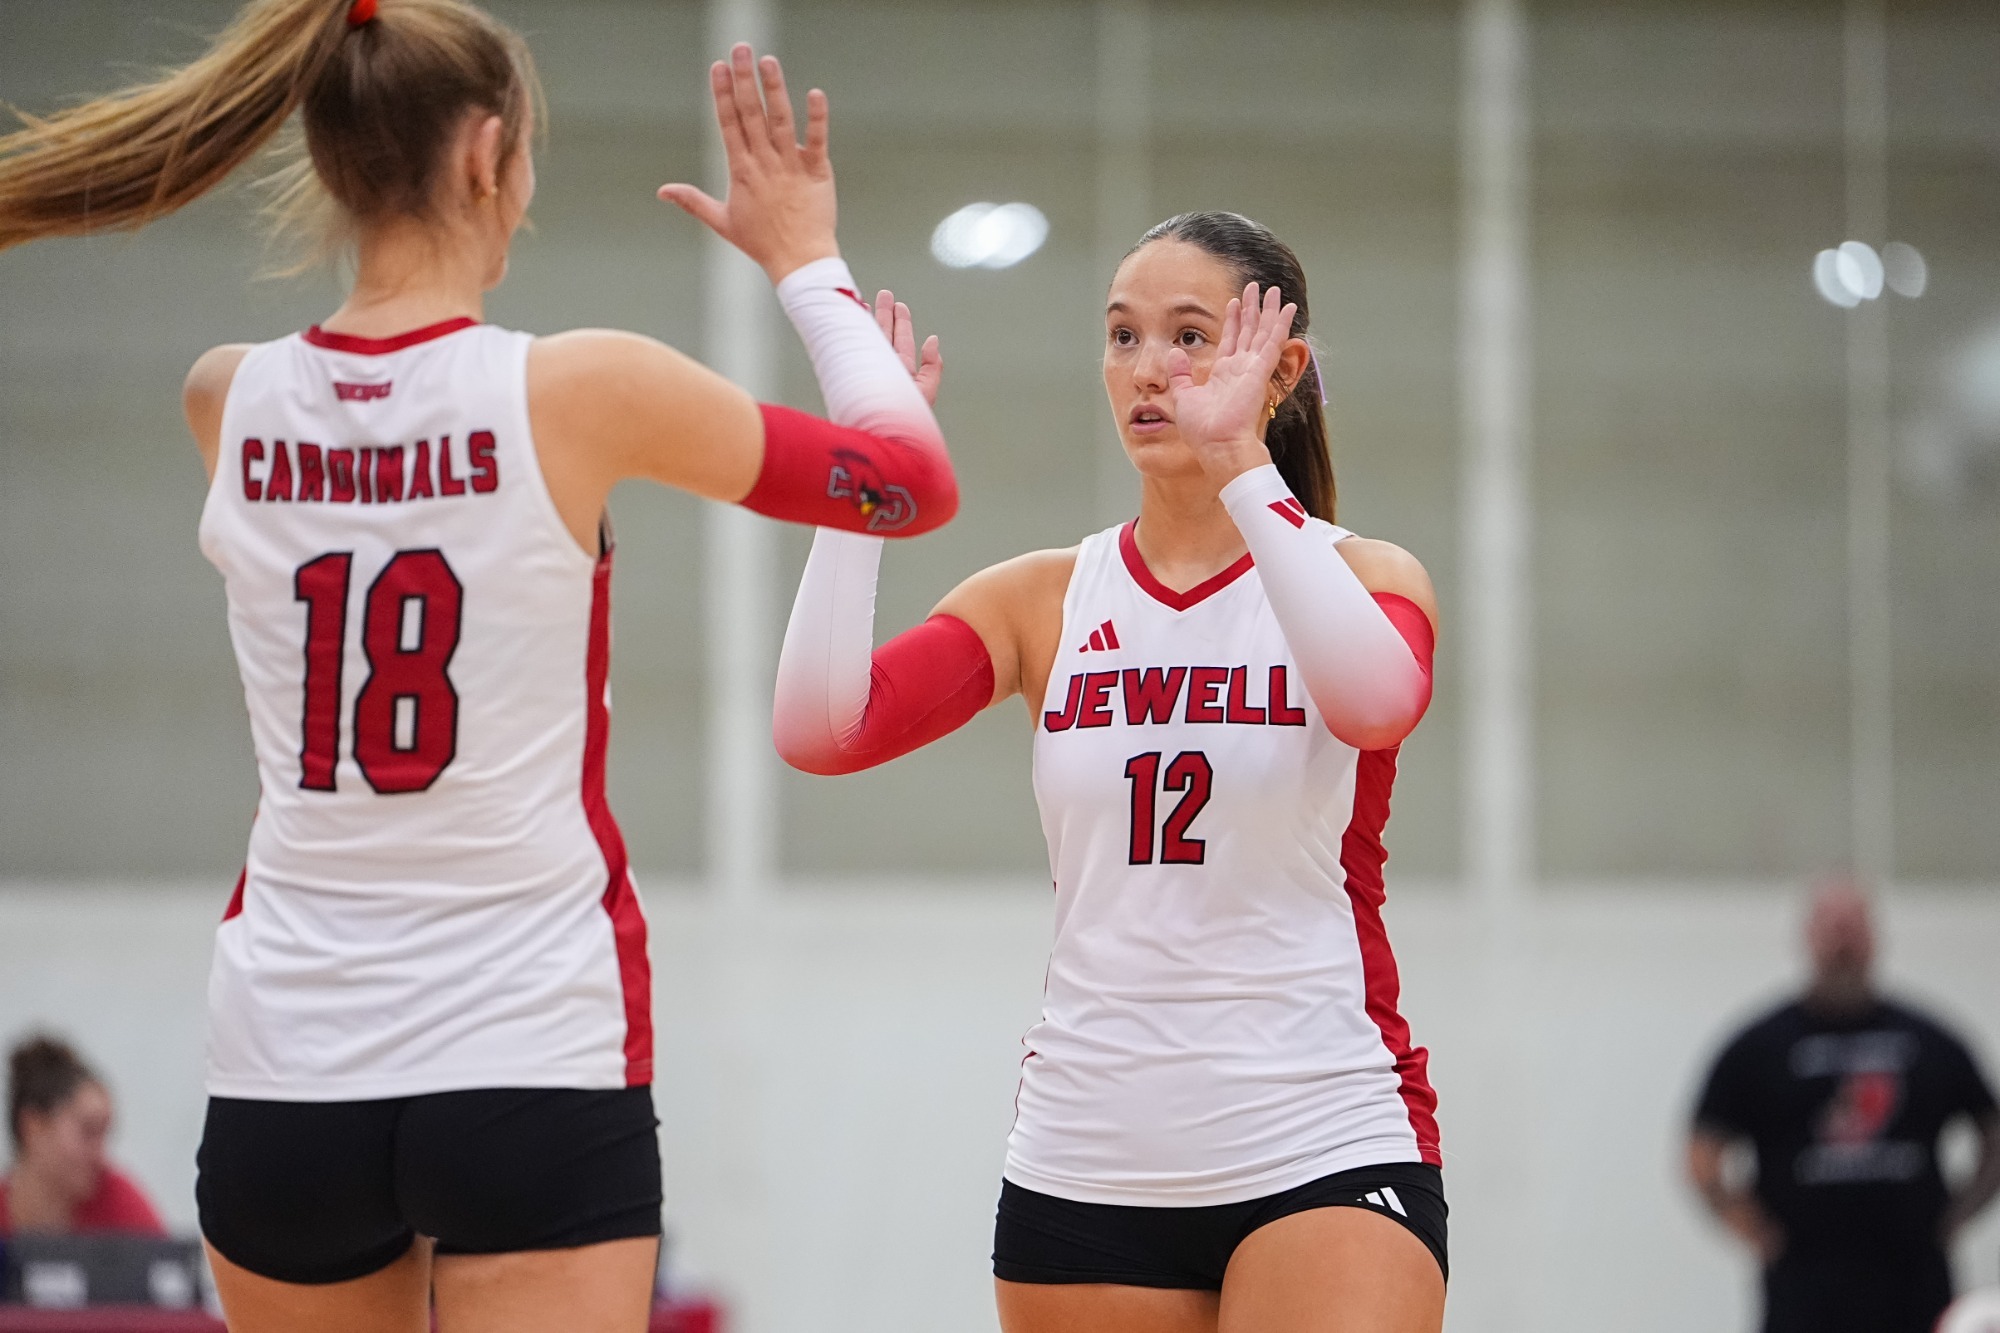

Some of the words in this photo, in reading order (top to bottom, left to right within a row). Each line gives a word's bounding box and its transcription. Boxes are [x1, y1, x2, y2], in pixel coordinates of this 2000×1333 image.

[241, 431, 499, 503] CARDINALS
[294, 548, 463, 795] 18
[1044, 665, 1306, 733] JEWELL
[1124, 751, 1213, 866] 12
